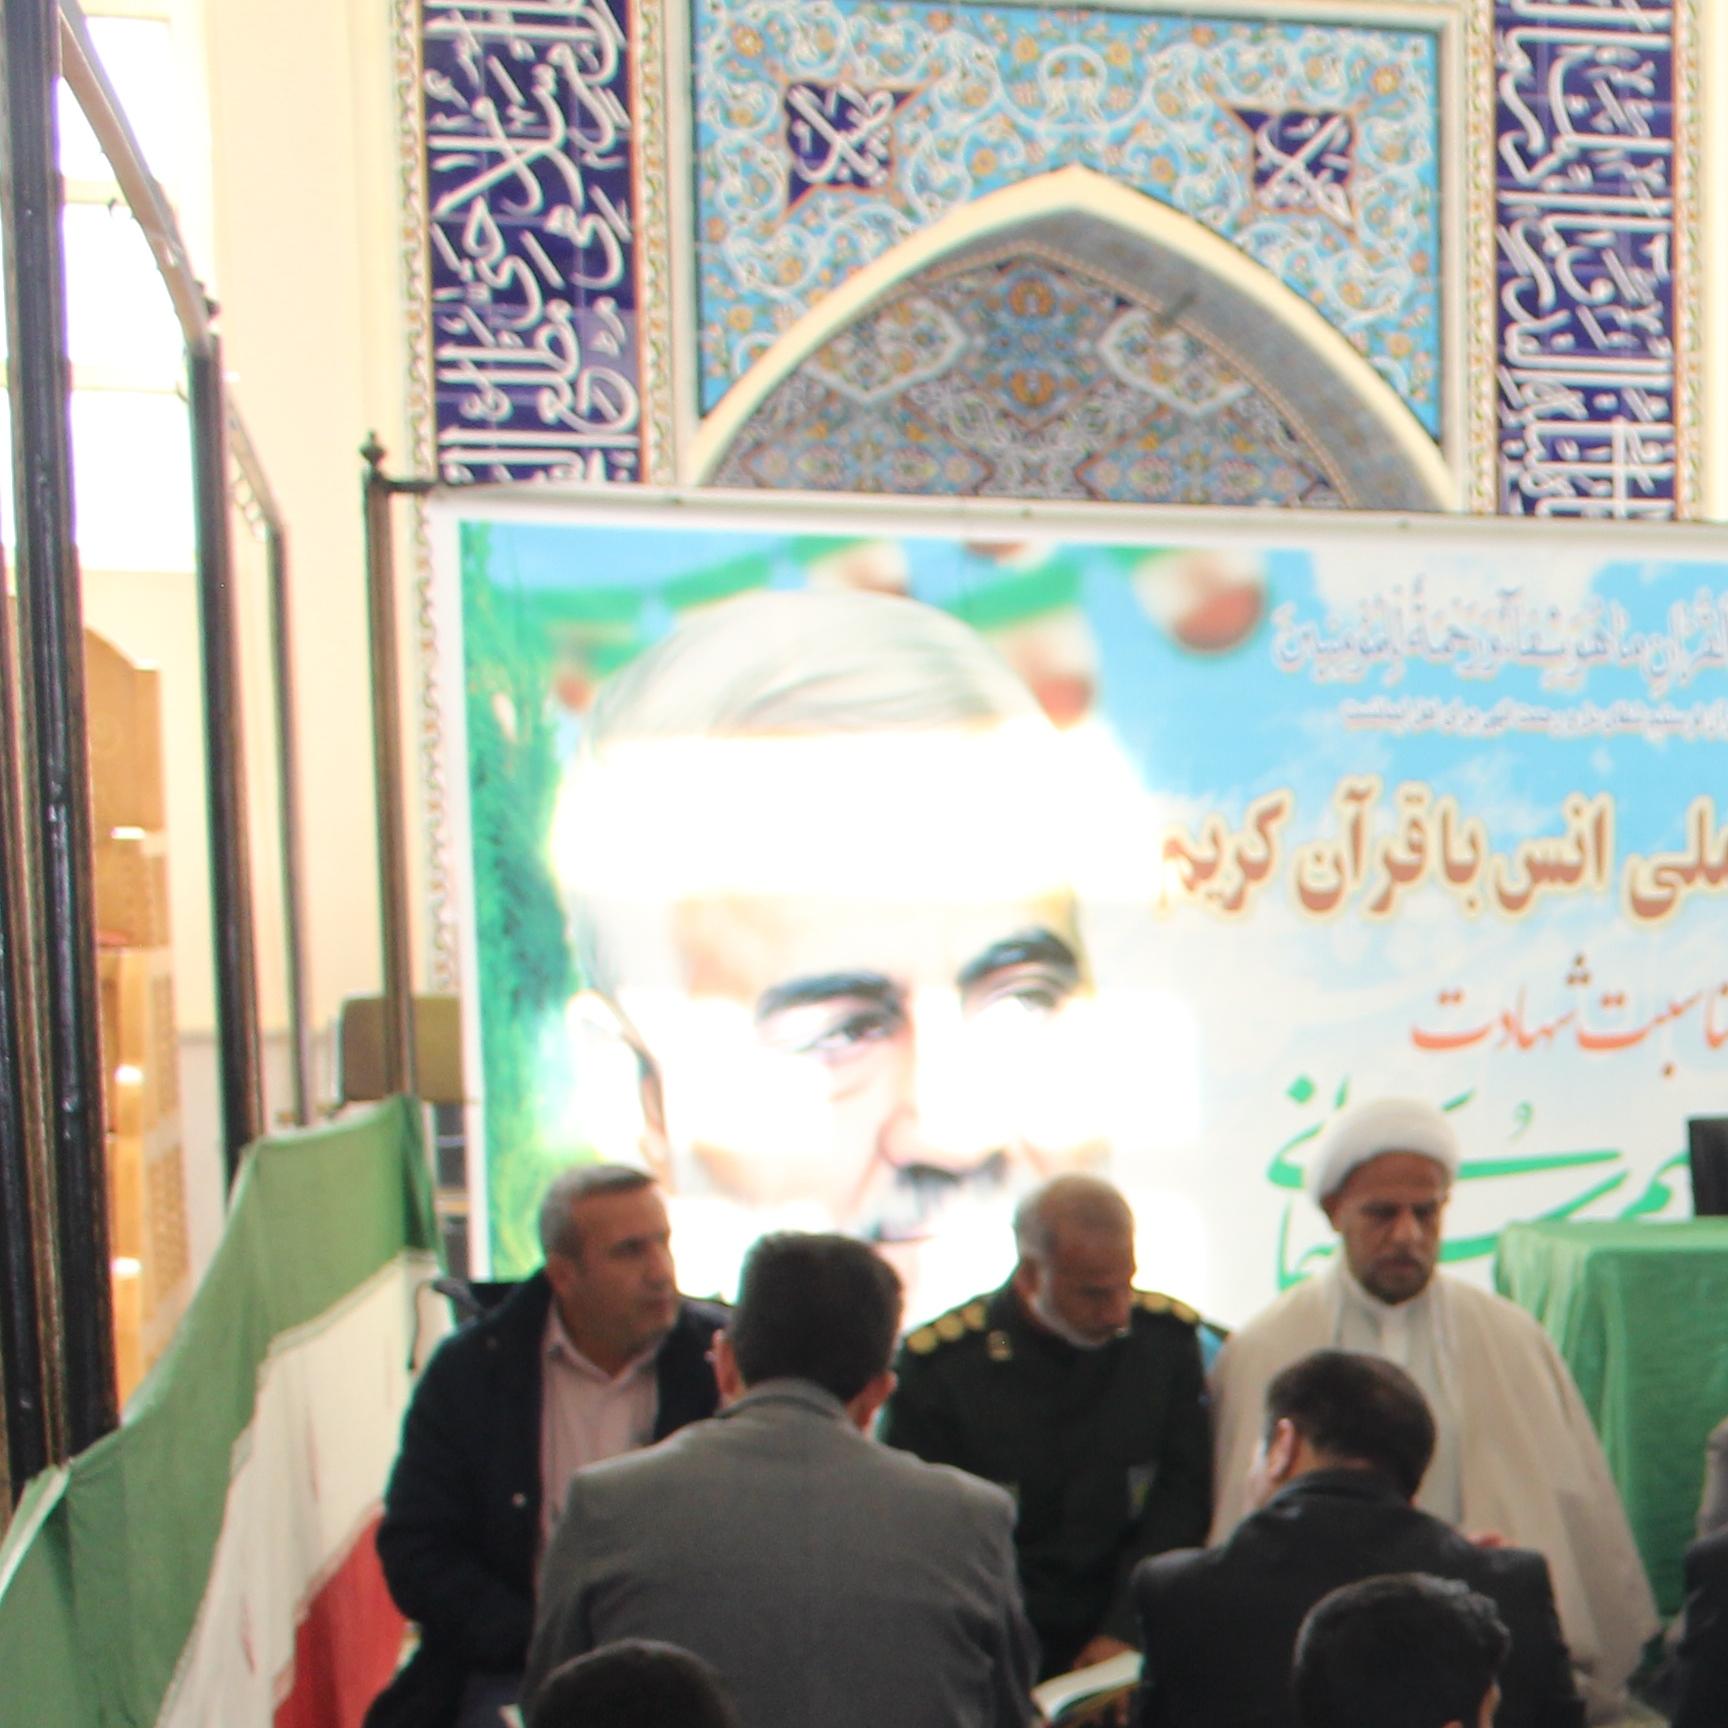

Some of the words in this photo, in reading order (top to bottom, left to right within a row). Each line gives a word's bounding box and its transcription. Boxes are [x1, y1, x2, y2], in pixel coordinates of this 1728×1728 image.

[1297, 787, 1426, 914] قرآن
[1441, 809, 1479, 909] با
[1494, 808, 1606, 912] انس
[1411, 953, 1592, 1051] شهادت
